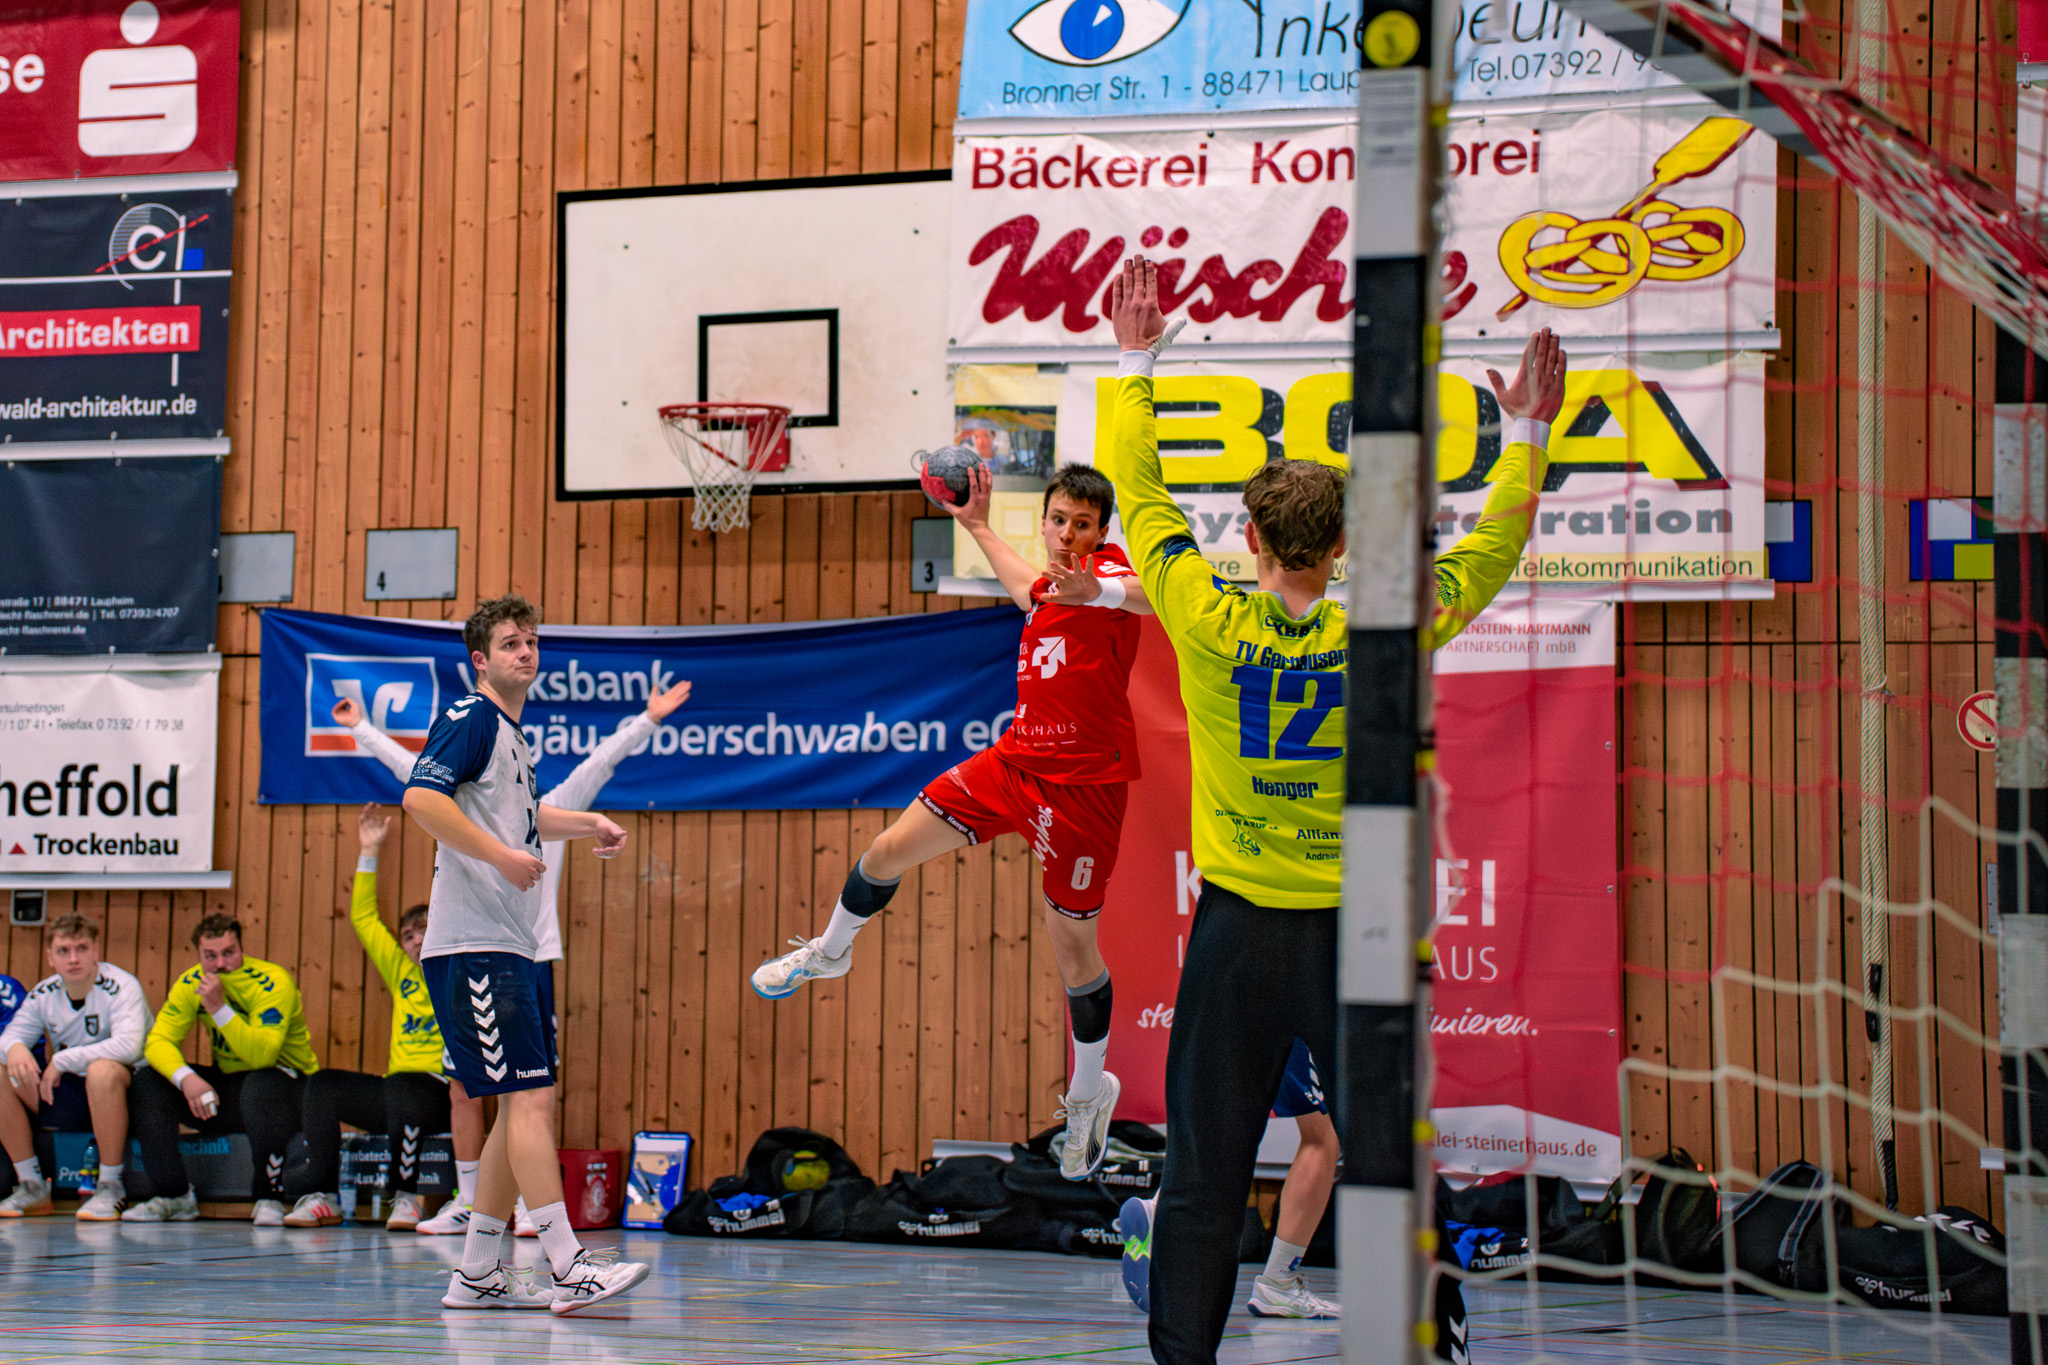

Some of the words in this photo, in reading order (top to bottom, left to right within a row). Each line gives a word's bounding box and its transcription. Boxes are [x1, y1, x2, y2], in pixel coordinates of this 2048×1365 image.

[1002, 82, 1101, 104] Bronner
[1109, 76, 1145, 100] Str.
[1161, 76, 1170, 98] 1
[1202, 69, 1283, 97] 88471
[971, 142, 1207, 190] Bäckerei
[376, 571, 387, 591] 4
[924, 561, 934, 583] 3
[1235, 640, 1259, 662] TV
[1439, 640, 1539, 653] ARTNERSCHAFT
[1230, 664, 1345, 761] 12
[1251, 774, 1320, 801] Henger
[33, 832, 179, 855] Trockenbau
[1070, 856, 1095, 890] 6
[1430, 1128, 1598, 1157] lei-steinerhaus.de
